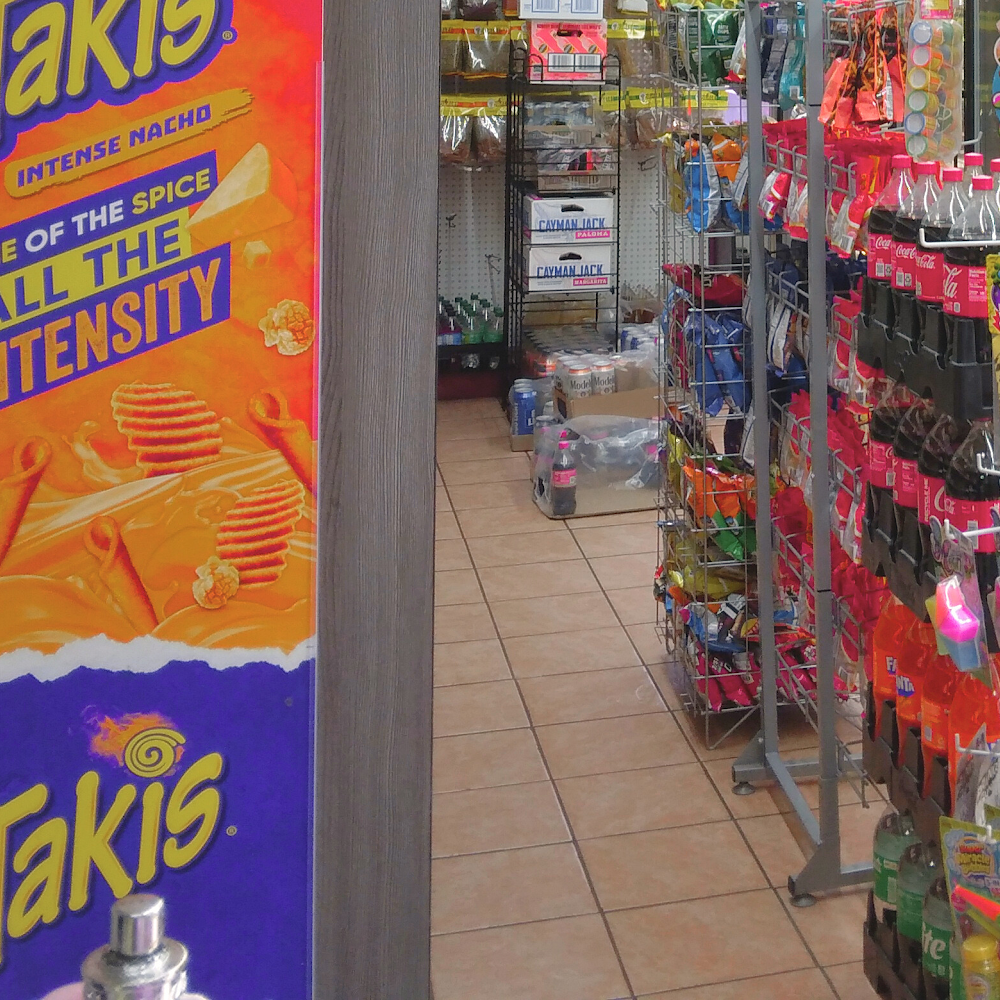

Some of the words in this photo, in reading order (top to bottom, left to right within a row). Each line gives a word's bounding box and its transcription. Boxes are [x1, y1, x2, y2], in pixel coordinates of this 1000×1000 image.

[16, 136, 122, 189] INTENSE
[129, 103, 213, 149] NACHO
[25, 221, 65, 254] OF
[70, 198, 125, 240] THE
[131, 169, 212, 217] SPICE
[538, 218, 578, 232] CAYMAN
[582, 217, 606, 230] JACK
[89, 220, 183, 286] THE
[537, 264, 576, 279] CAYMAN
[580, 264, 604, 277] JACK
